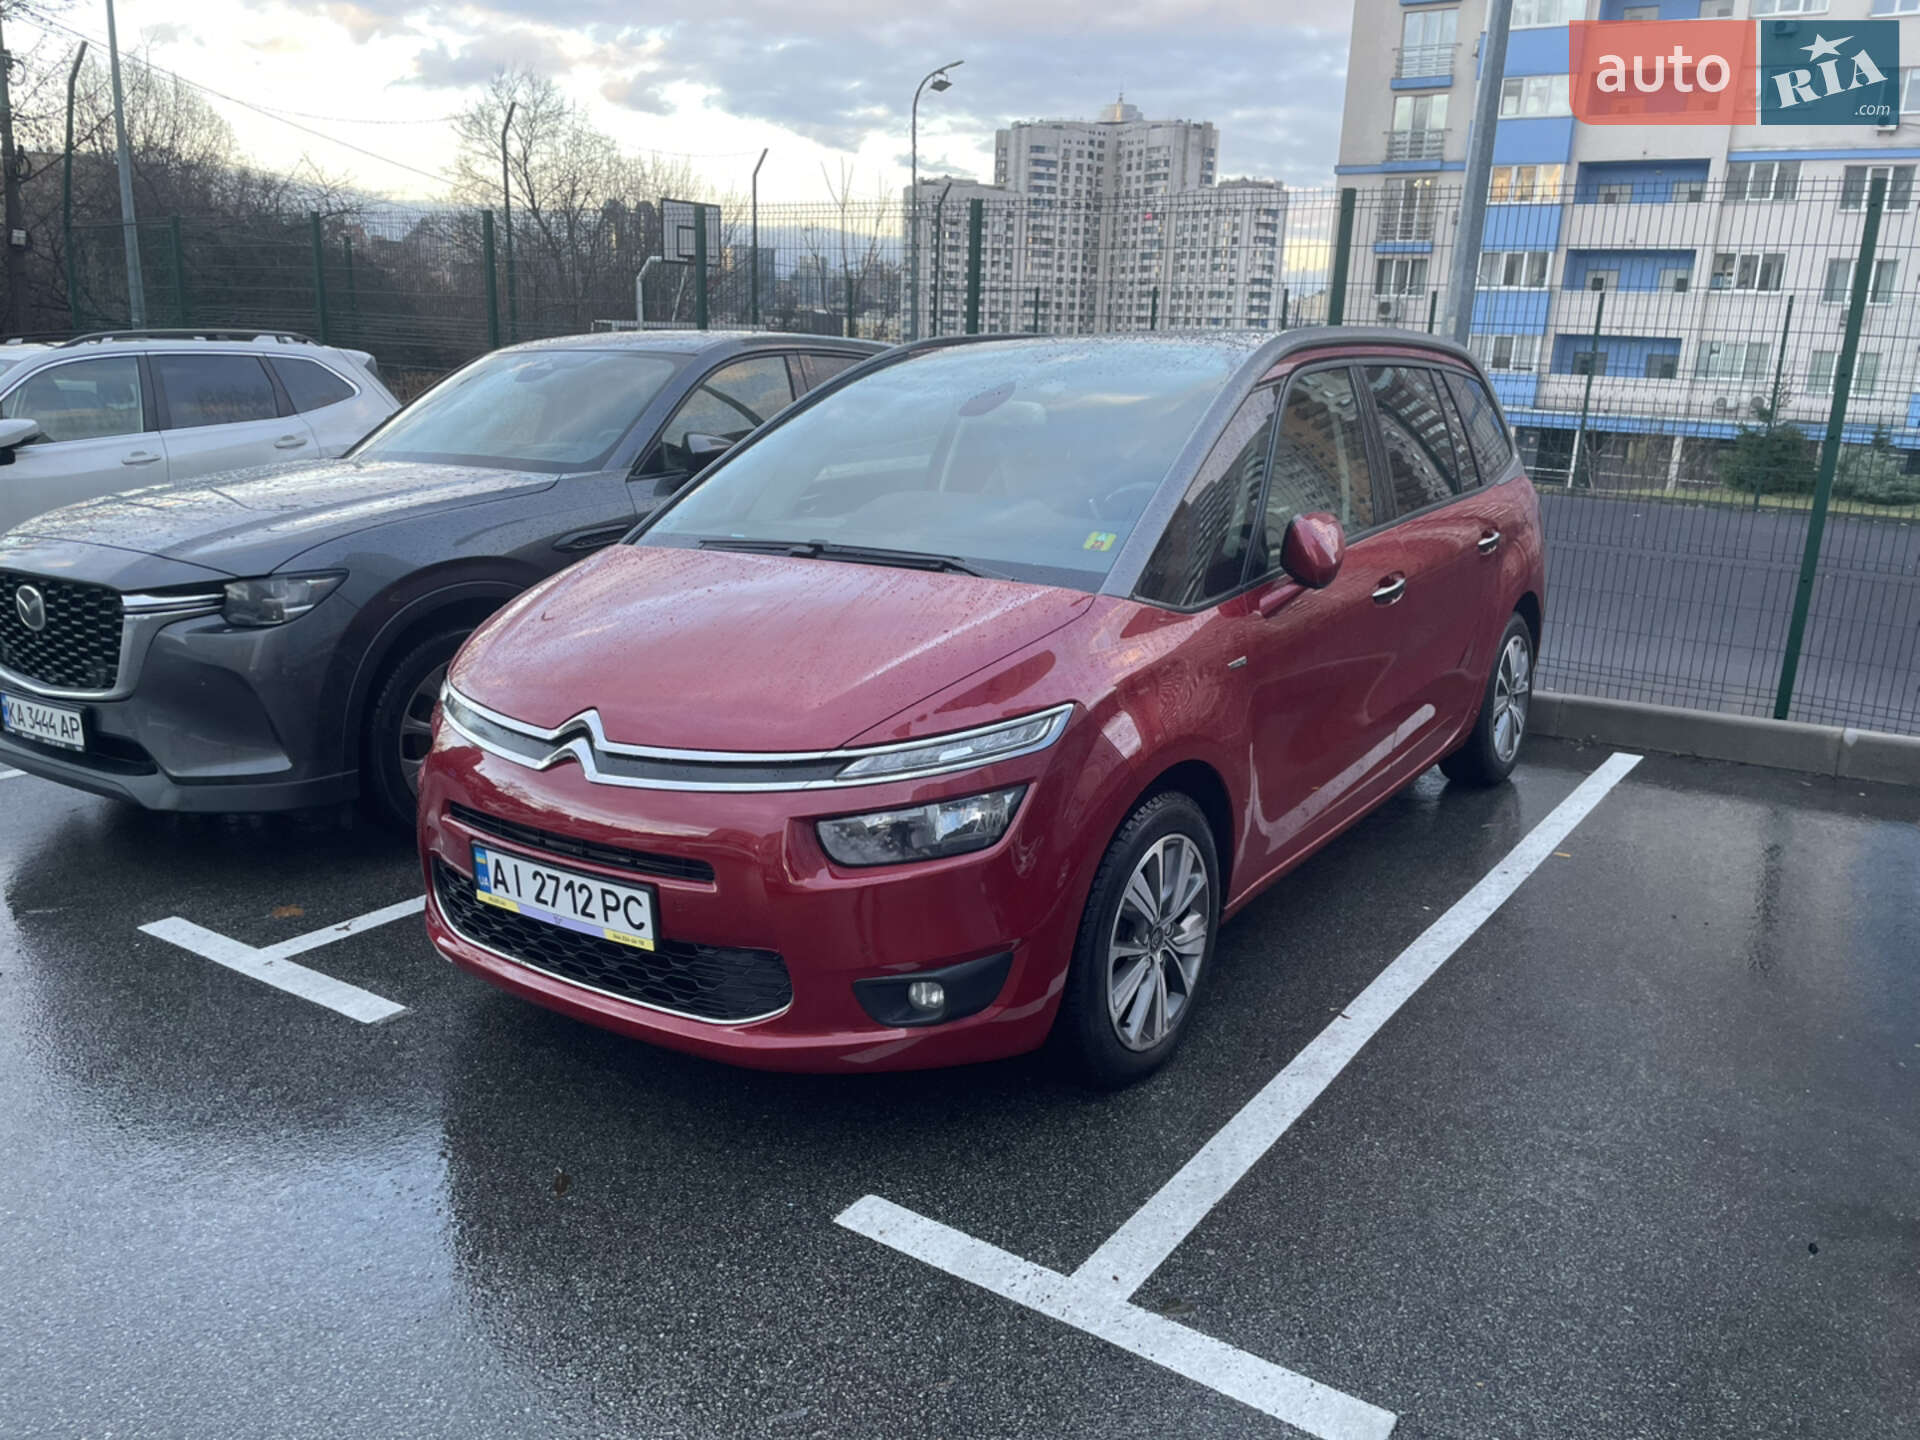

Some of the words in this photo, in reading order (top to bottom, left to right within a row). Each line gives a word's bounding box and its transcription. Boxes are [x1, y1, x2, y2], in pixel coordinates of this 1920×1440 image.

[8, 701, 26, 727] KA
[27, 706, 57, 736] 3444
[61, 715, 80, 739] AP
[493, 858, 522, 898] AI
[532, 870, 596, 919] 2712
[601, 887, 646, 931] PC
